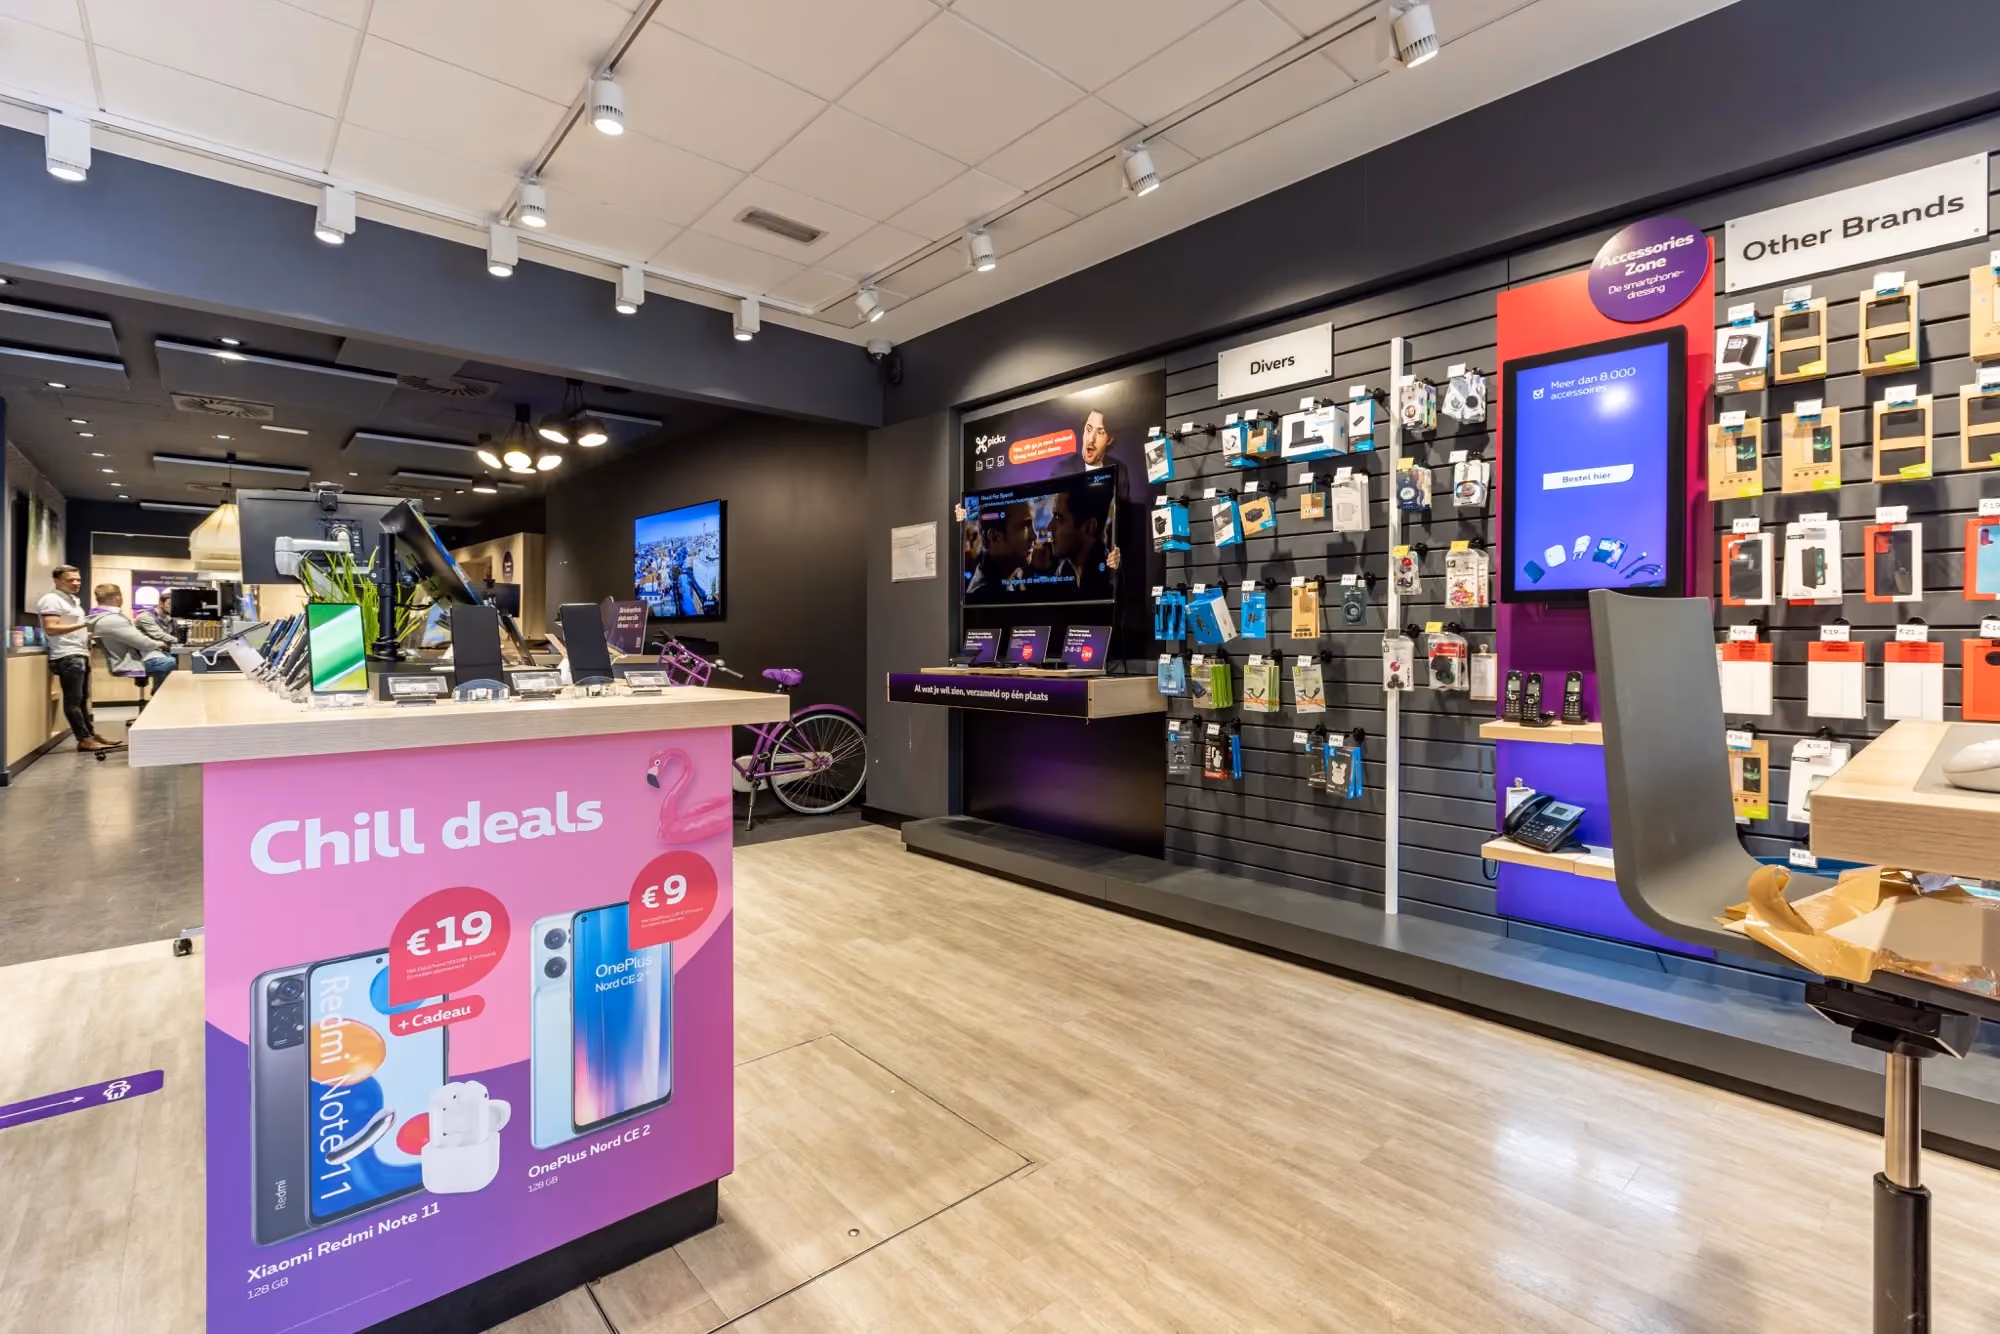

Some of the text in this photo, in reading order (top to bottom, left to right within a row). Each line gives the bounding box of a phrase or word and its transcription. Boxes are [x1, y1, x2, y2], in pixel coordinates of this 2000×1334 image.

[1742, 194, 1965, 261] Other Brands
[1599, 234, 1695, 269] Accessories
[1624, 257, 1667, 276] Zone
[1608, 270, 1685, 295] De smartphone-
[1627, 284, 1666, 300] dressing
[1250, 355, 1295, 376] Divers
[1551, 366, 1637, 390] Meer dan 8.000
[1550, 384, 1608, 400] accessoires
[987, 434, 1007, 448] pickx
[1562, 472, 1612, 484] Bestel hier
[921, 685, 933, 694] wat
[933, 685, 940, 695] je
[940, 686, 951, 695] wil
[951, 686, 966, 697] zien,
[966, 688, 1000, 698] verzameld
[1001, 691, 1010, 700] op
[1011, 689, 1024, 700] één
[1024, 690, 1049, 702] plaats
[250, 790, 604, 875] Chill deals
[595, 955, 654, 978] OnePlus
[595, 972, 645, 993] Nord CE 2
[320, 976, 351, 1064] Redmi
[411, 1005, 472, 1027] Cadeau
[320, 1074, 351, 1153] Note
[528, 1124, 651, 1178] OnePlus Nord CE 2
[320, 1164, 351, 1200] 11
[528, 1175, 559, 1193] 128 GB
[275, 1179, 287, 1210] Redmi
[247, 1201, 441, 1283] Xiaomi Redmi Note 11
[247, 1277, 289, 1300] 128 GB
